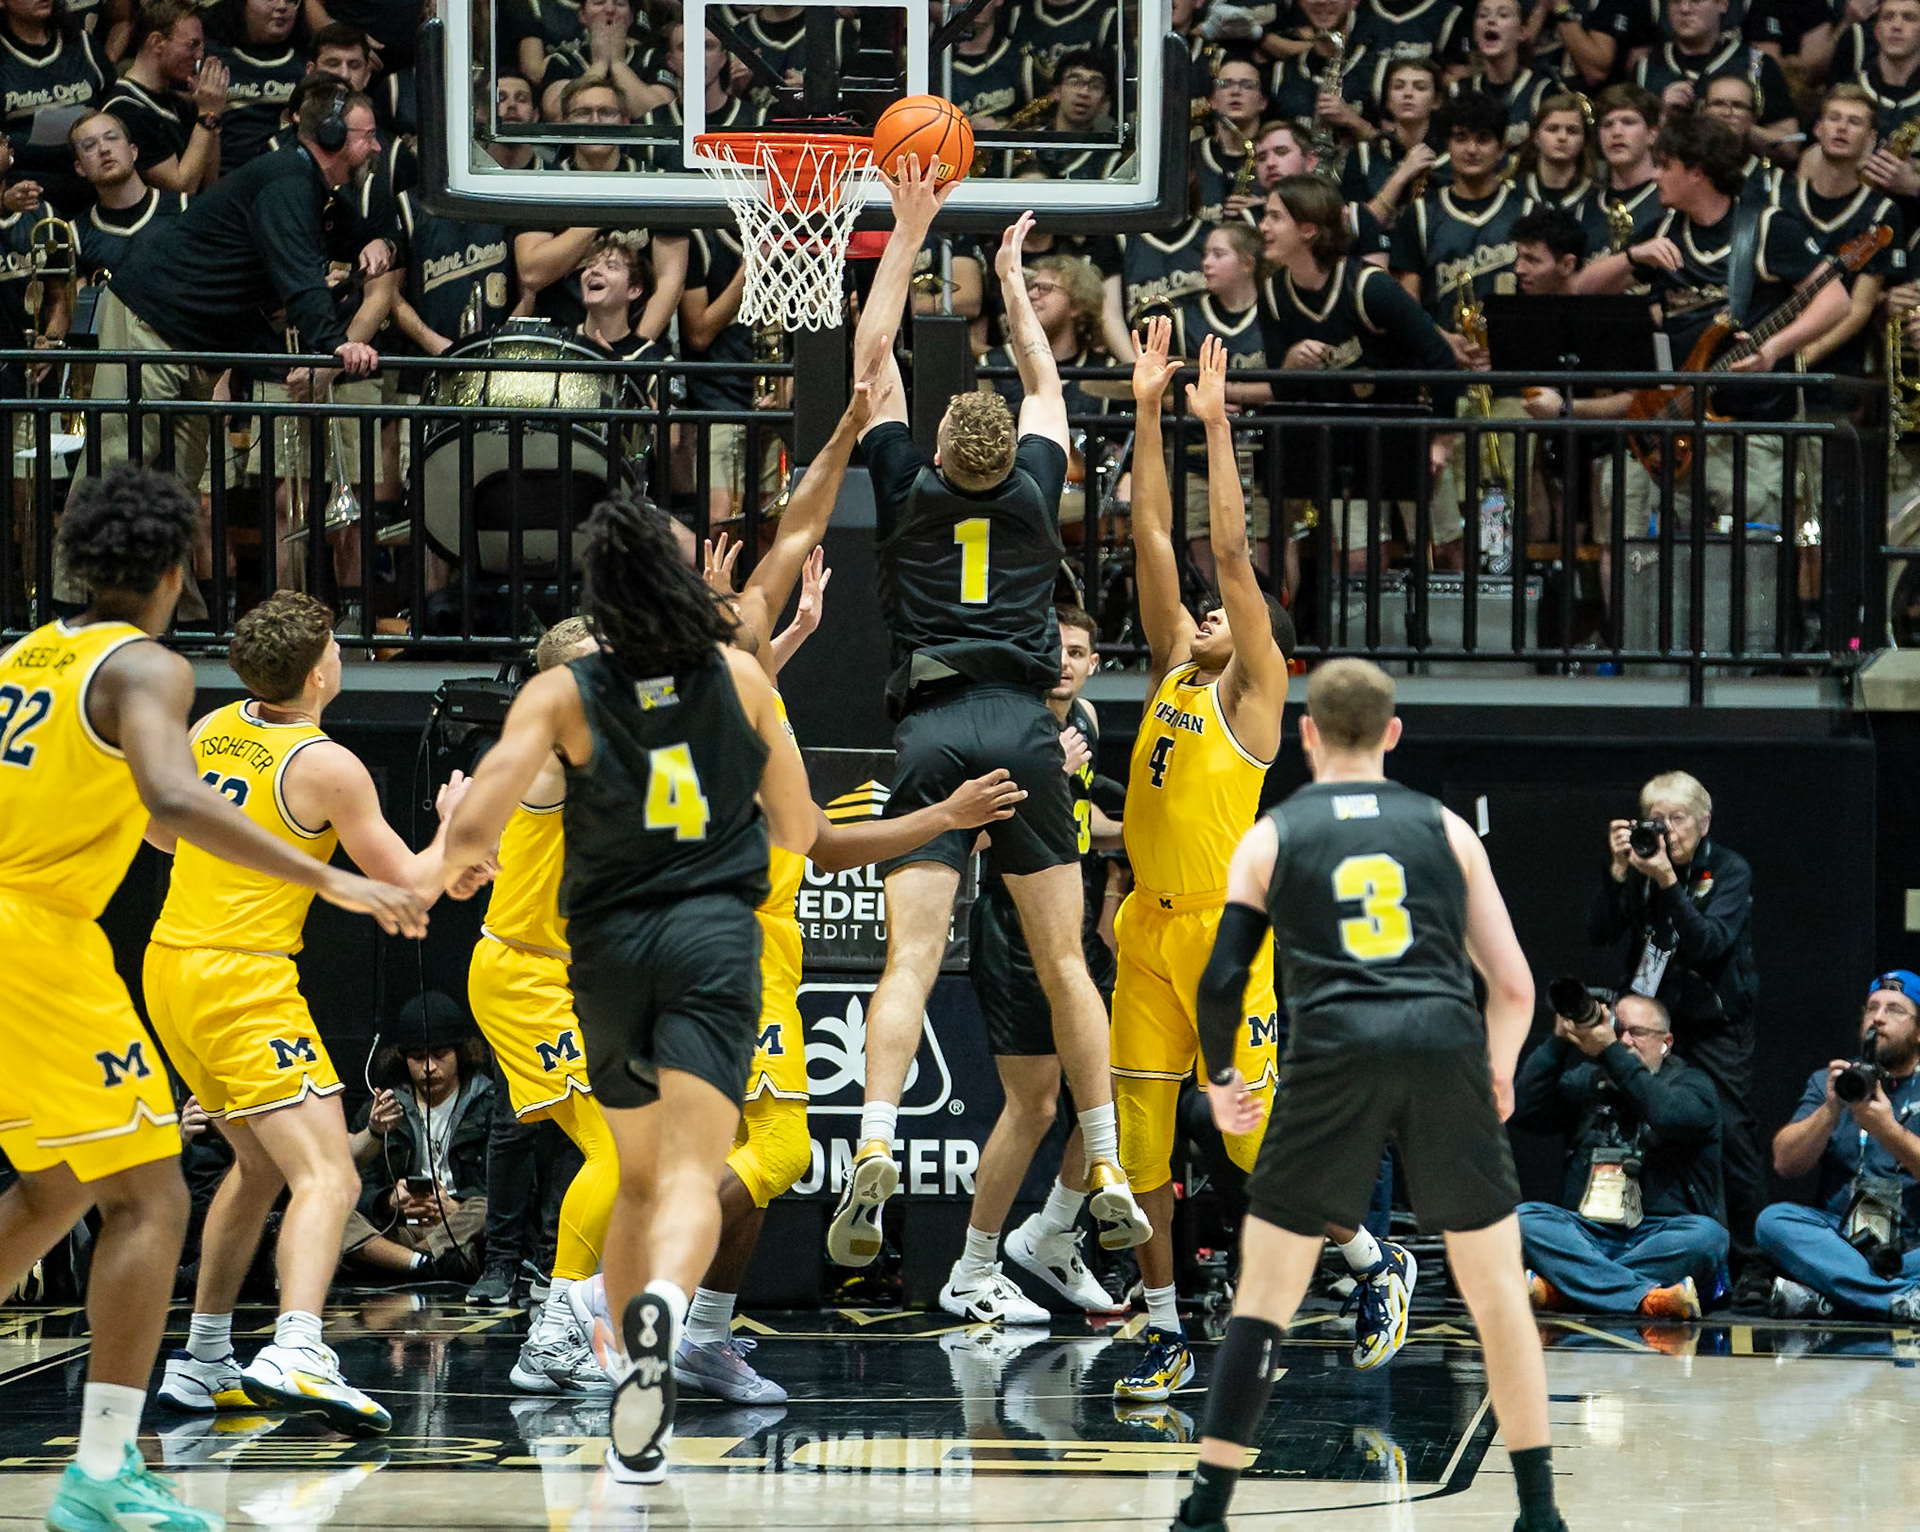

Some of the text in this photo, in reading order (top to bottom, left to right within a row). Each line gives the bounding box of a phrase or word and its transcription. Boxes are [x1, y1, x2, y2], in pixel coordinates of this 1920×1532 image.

[953, 517, 991, 604] 1
[200, 736, 274, 775] TSCHETTER
[1148, 736, 1176, 788] 4
[643, 741, 711, 842] 4
[1331, 852, 1415, 962] 3
[797, 922, 862, 941] REDIT
[535, 1030, 581, 1073] M
[1247, 1012, 1277, 1047] M
[95, 1041, 151, 1088] M
[268, 1036, 318, 1071] M
